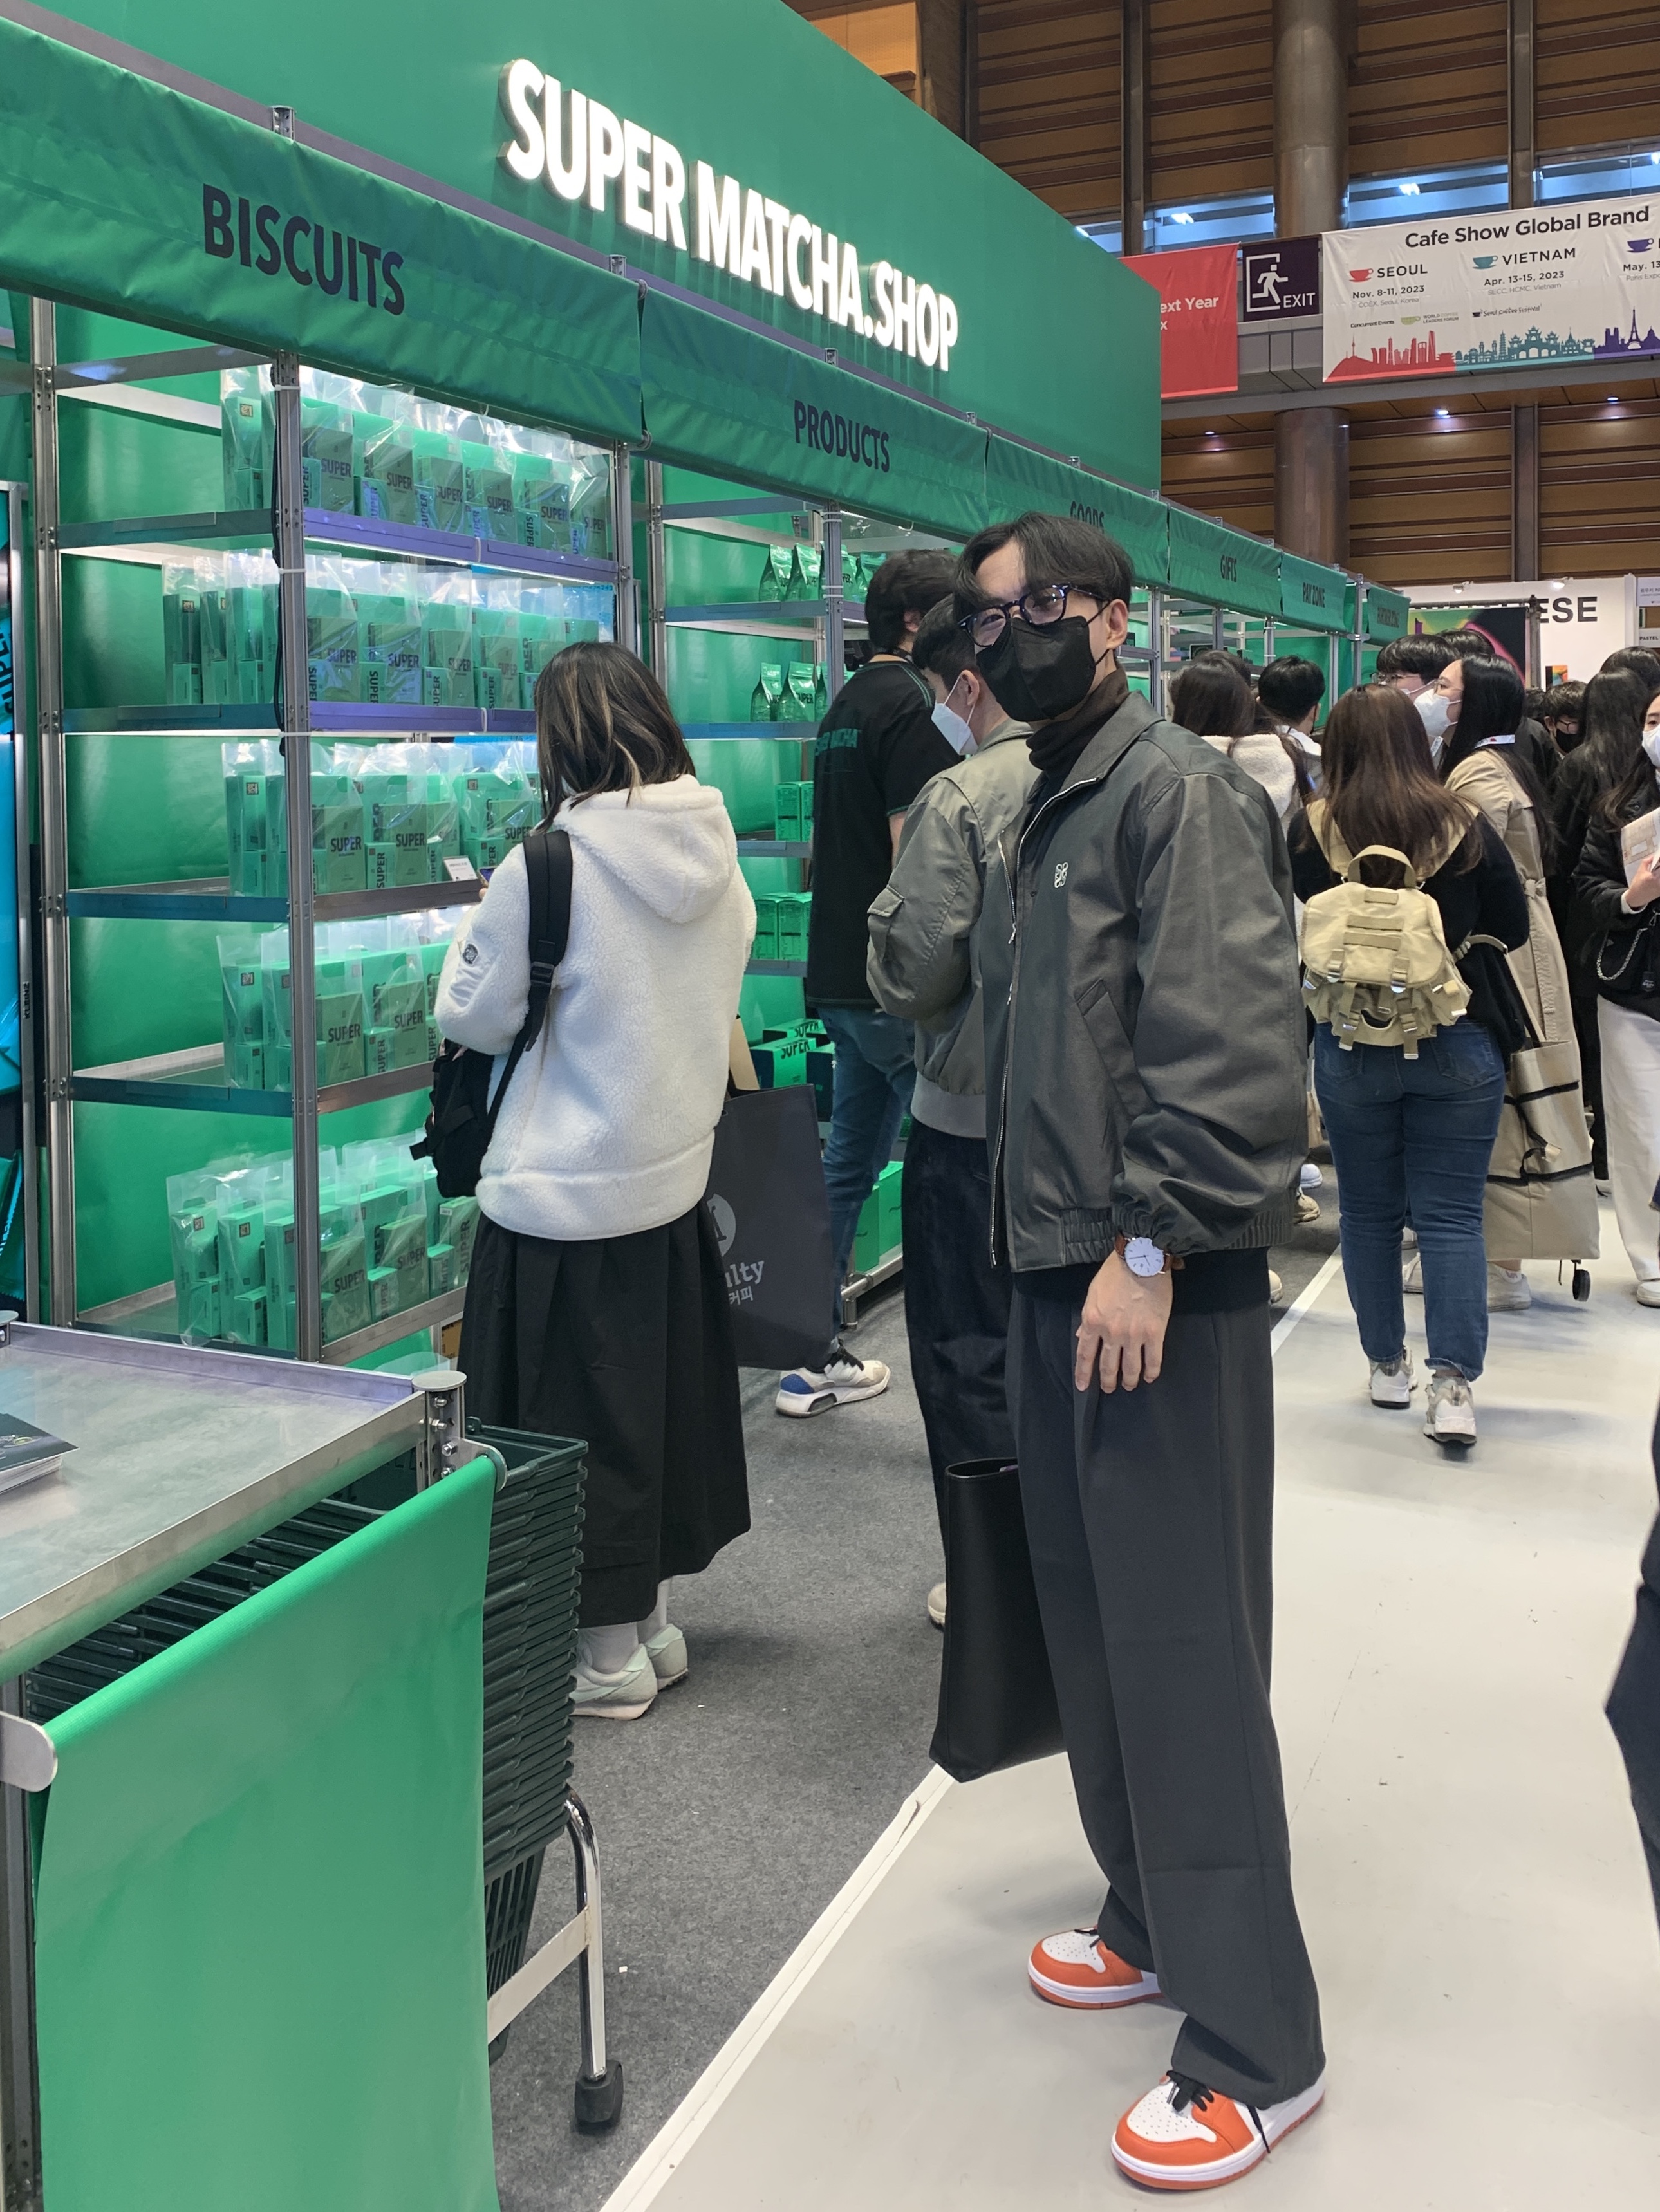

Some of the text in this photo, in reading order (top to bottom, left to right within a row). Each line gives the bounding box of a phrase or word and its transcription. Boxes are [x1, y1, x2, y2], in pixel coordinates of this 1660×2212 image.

[496, 58, 958, 372] SUPER MATCHA.SHOP
[1405, 206, 1649, 248] Cafe Show Global Brand
[203, 183, 405, 316] BISCUITS
[1502, 248, 1576, 265] VIETNAM
[1377, 264, 1428, 278] SEOUL
[1623, 263, 1648, 272] May.
[1484, 270, 1565, 286] Apr. 13-15, 2023
[1283, 292, 1316, 308] EXIT
[1377, 288, 1397, 297] 8-11,
[1401, 285, 1425, 295] 2023
[1185, 297, 1219, 310] Year
[794, 399, 890, 473] PRODUCTS
[322, 458, 351, 478] SUPER
[386, 472, 413, 491] SUPER
[436, 485, 462, 503] SUPER
[487, 496, 512, 512] SUPER
[541, 506, 568, 522] SUPER
[1220, 555, 1237, 582] GIFTS
[1303, 582, 1325, 608] PAY ZONE
[327, 648, 357, 664] SUPER
[387, 653, 420, 669] SUPER
[449, 657, 471, 672] SUPER
[308, 667, 317, 702] SUPE
[330, 836, 362, 853] SUPER
[396, 832, 425, 848] SUPER
[377, 852, 385, 888] SUPER
[395, 1010, 424, 1029] SUPER
[328, 1023, 360, 1043] SUPER
[781, 1041, 810, 1060] SUPER
[460, 1220, 471, 1274] SUPER
[397, 1247, 425, 1270] SUPER
[334, 1269, 366, 1294] SUPER
[728, 1286, 753, 1305] 커피
